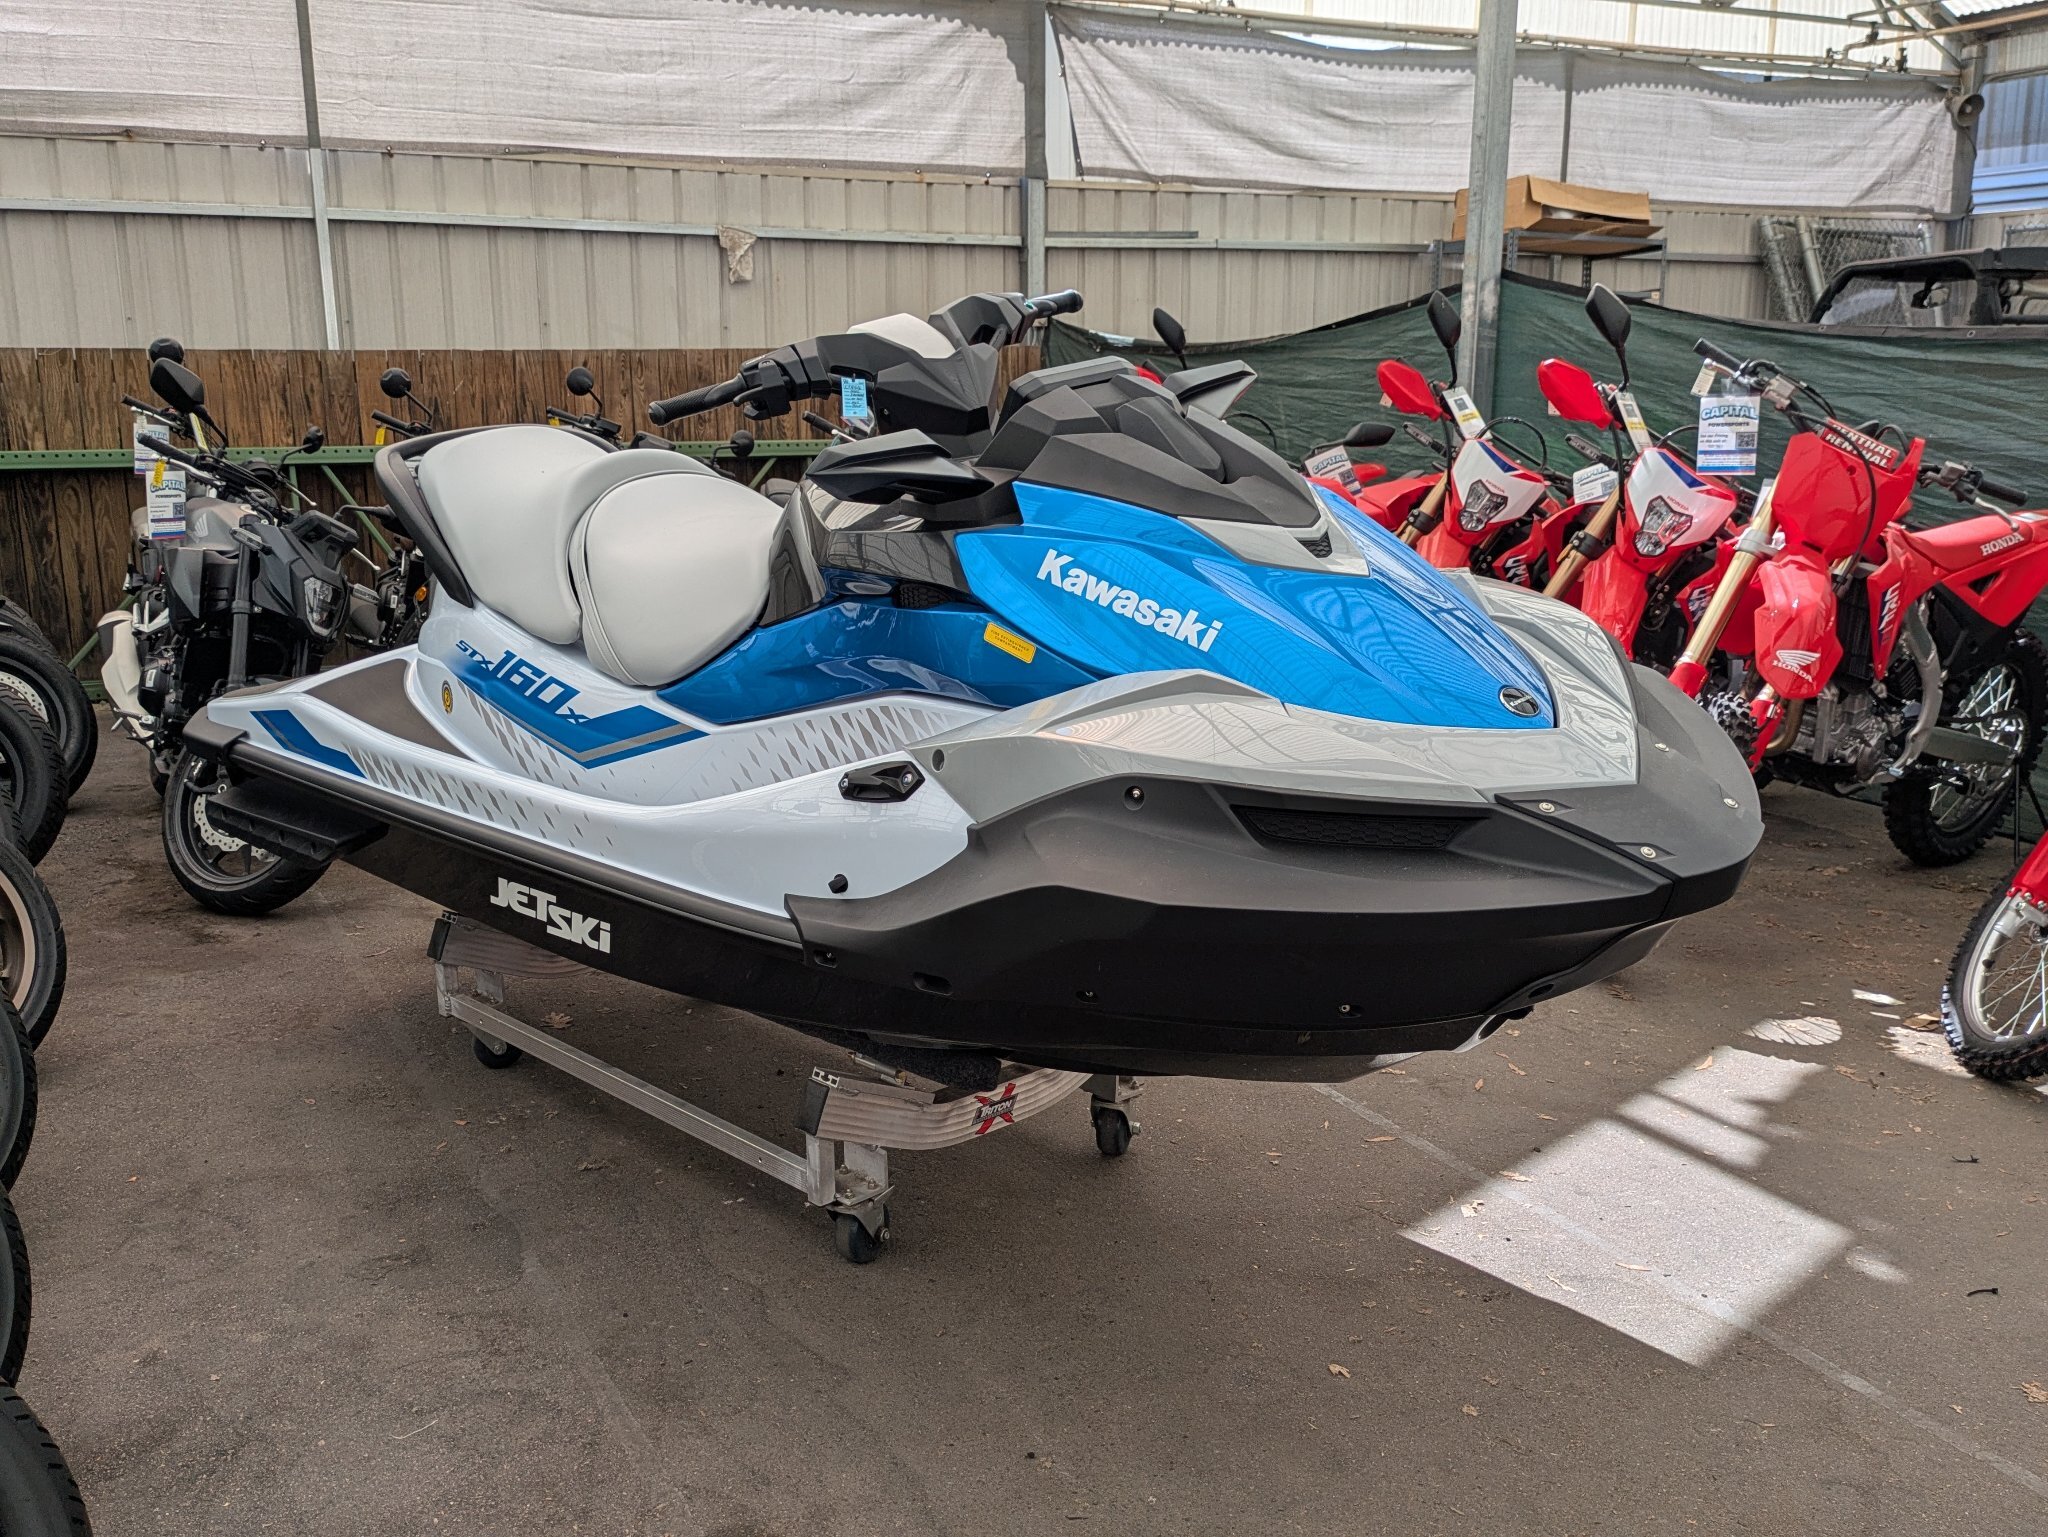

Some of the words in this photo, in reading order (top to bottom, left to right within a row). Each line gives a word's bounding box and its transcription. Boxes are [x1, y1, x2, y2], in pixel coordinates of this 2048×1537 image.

[1701, 405, 1759, 420] CAPITAL
[1980, 532, 2024, 556] HONDA
[1037, 549, 1223, 653] Kawasaki
[1772, 660, 1813, 683] HONDA
[980, 1100, 1013, 1118] TRITON
